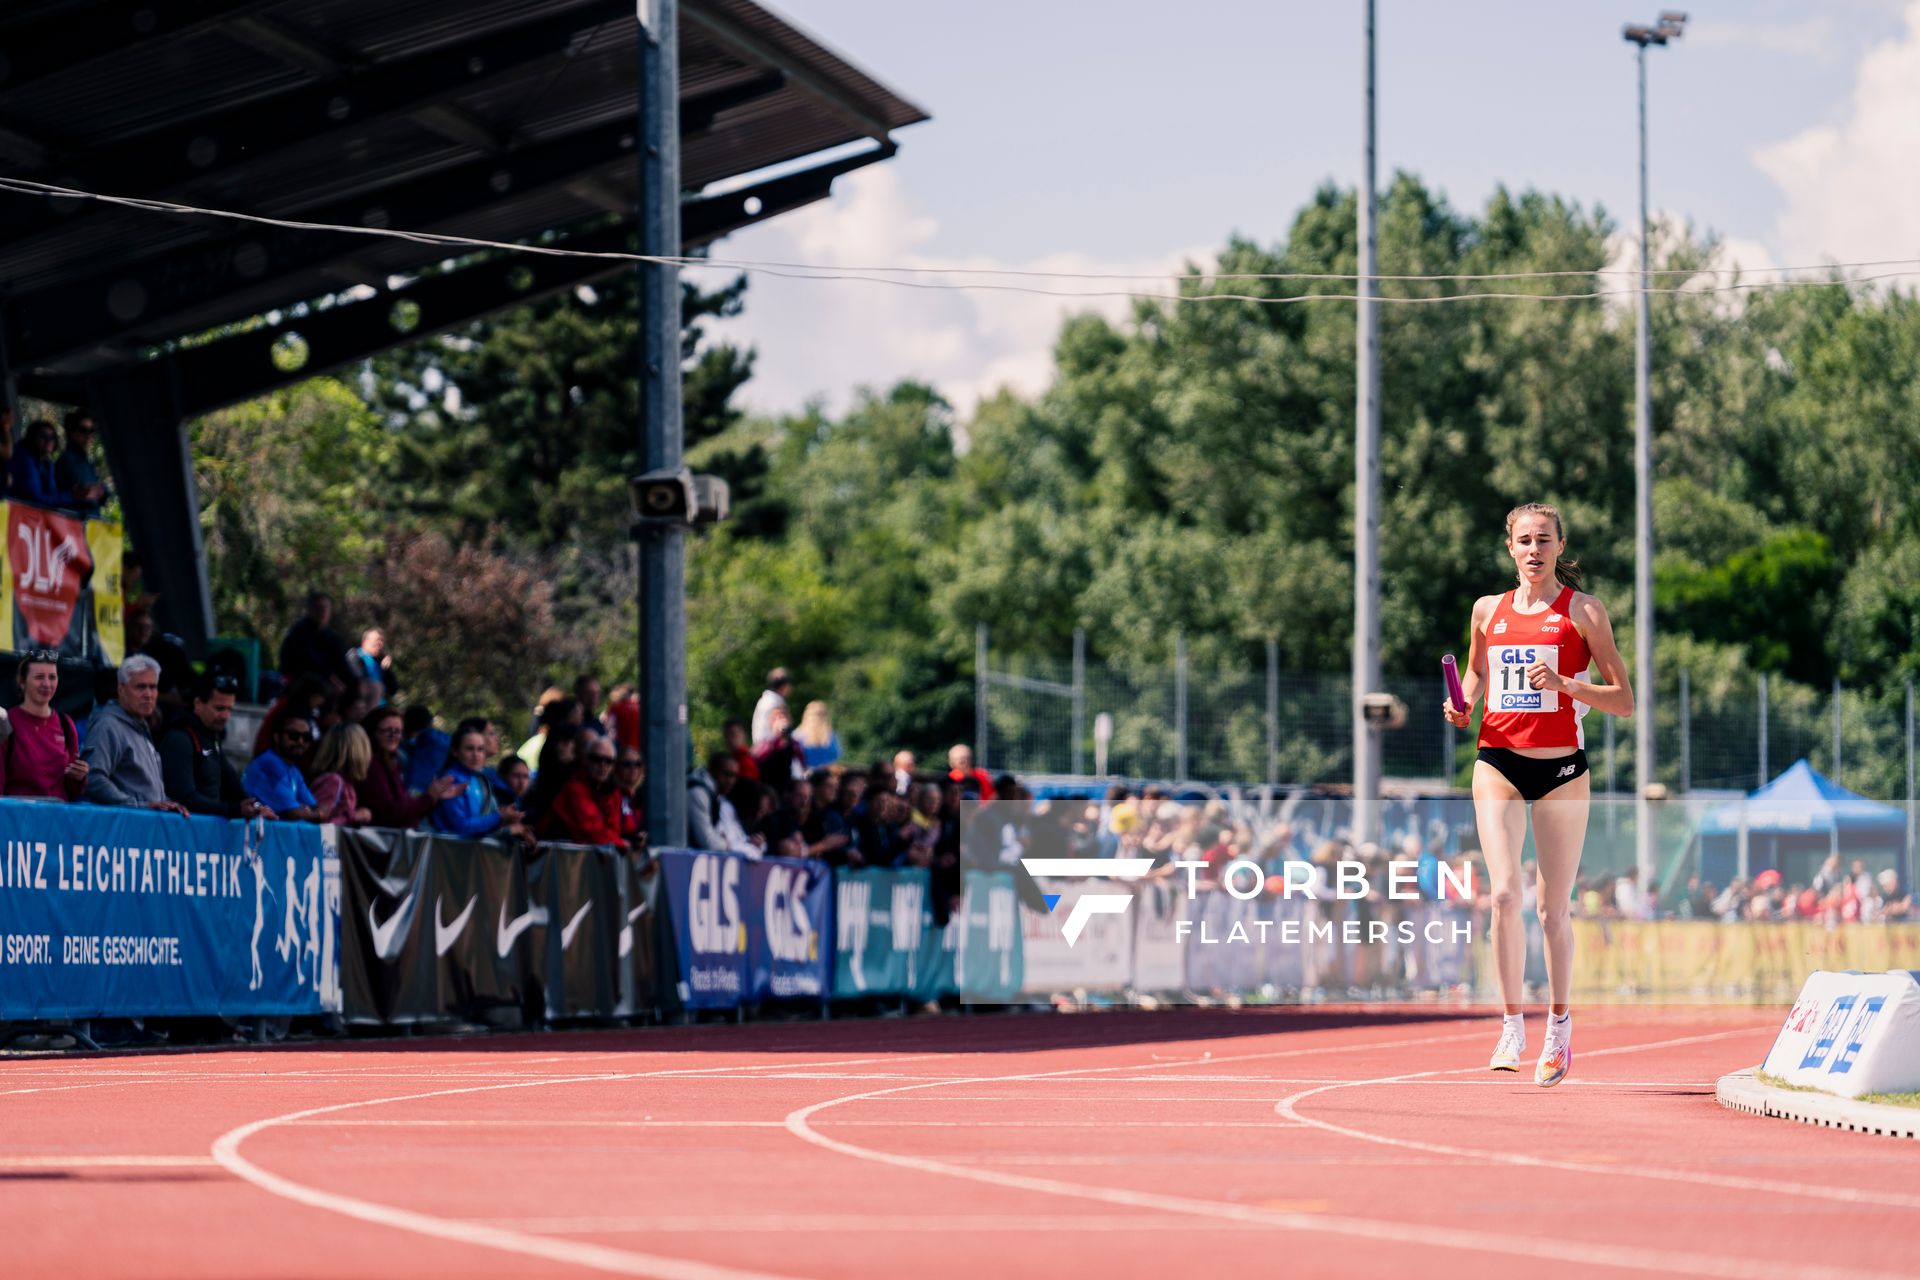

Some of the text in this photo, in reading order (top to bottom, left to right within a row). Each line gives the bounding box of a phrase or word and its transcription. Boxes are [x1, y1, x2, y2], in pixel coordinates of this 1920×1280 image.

[1501, 648, 1536, 664] GLS
[1516, 695, 1540, 703] PLAN
[58, 843, 242, 898] LEICHTATHLETIK
[7, 934, 52, 965] SPORT.
[63, 935, 100, 966] DEINE
[103, 936, 183, 966] GESCHICHTE.
